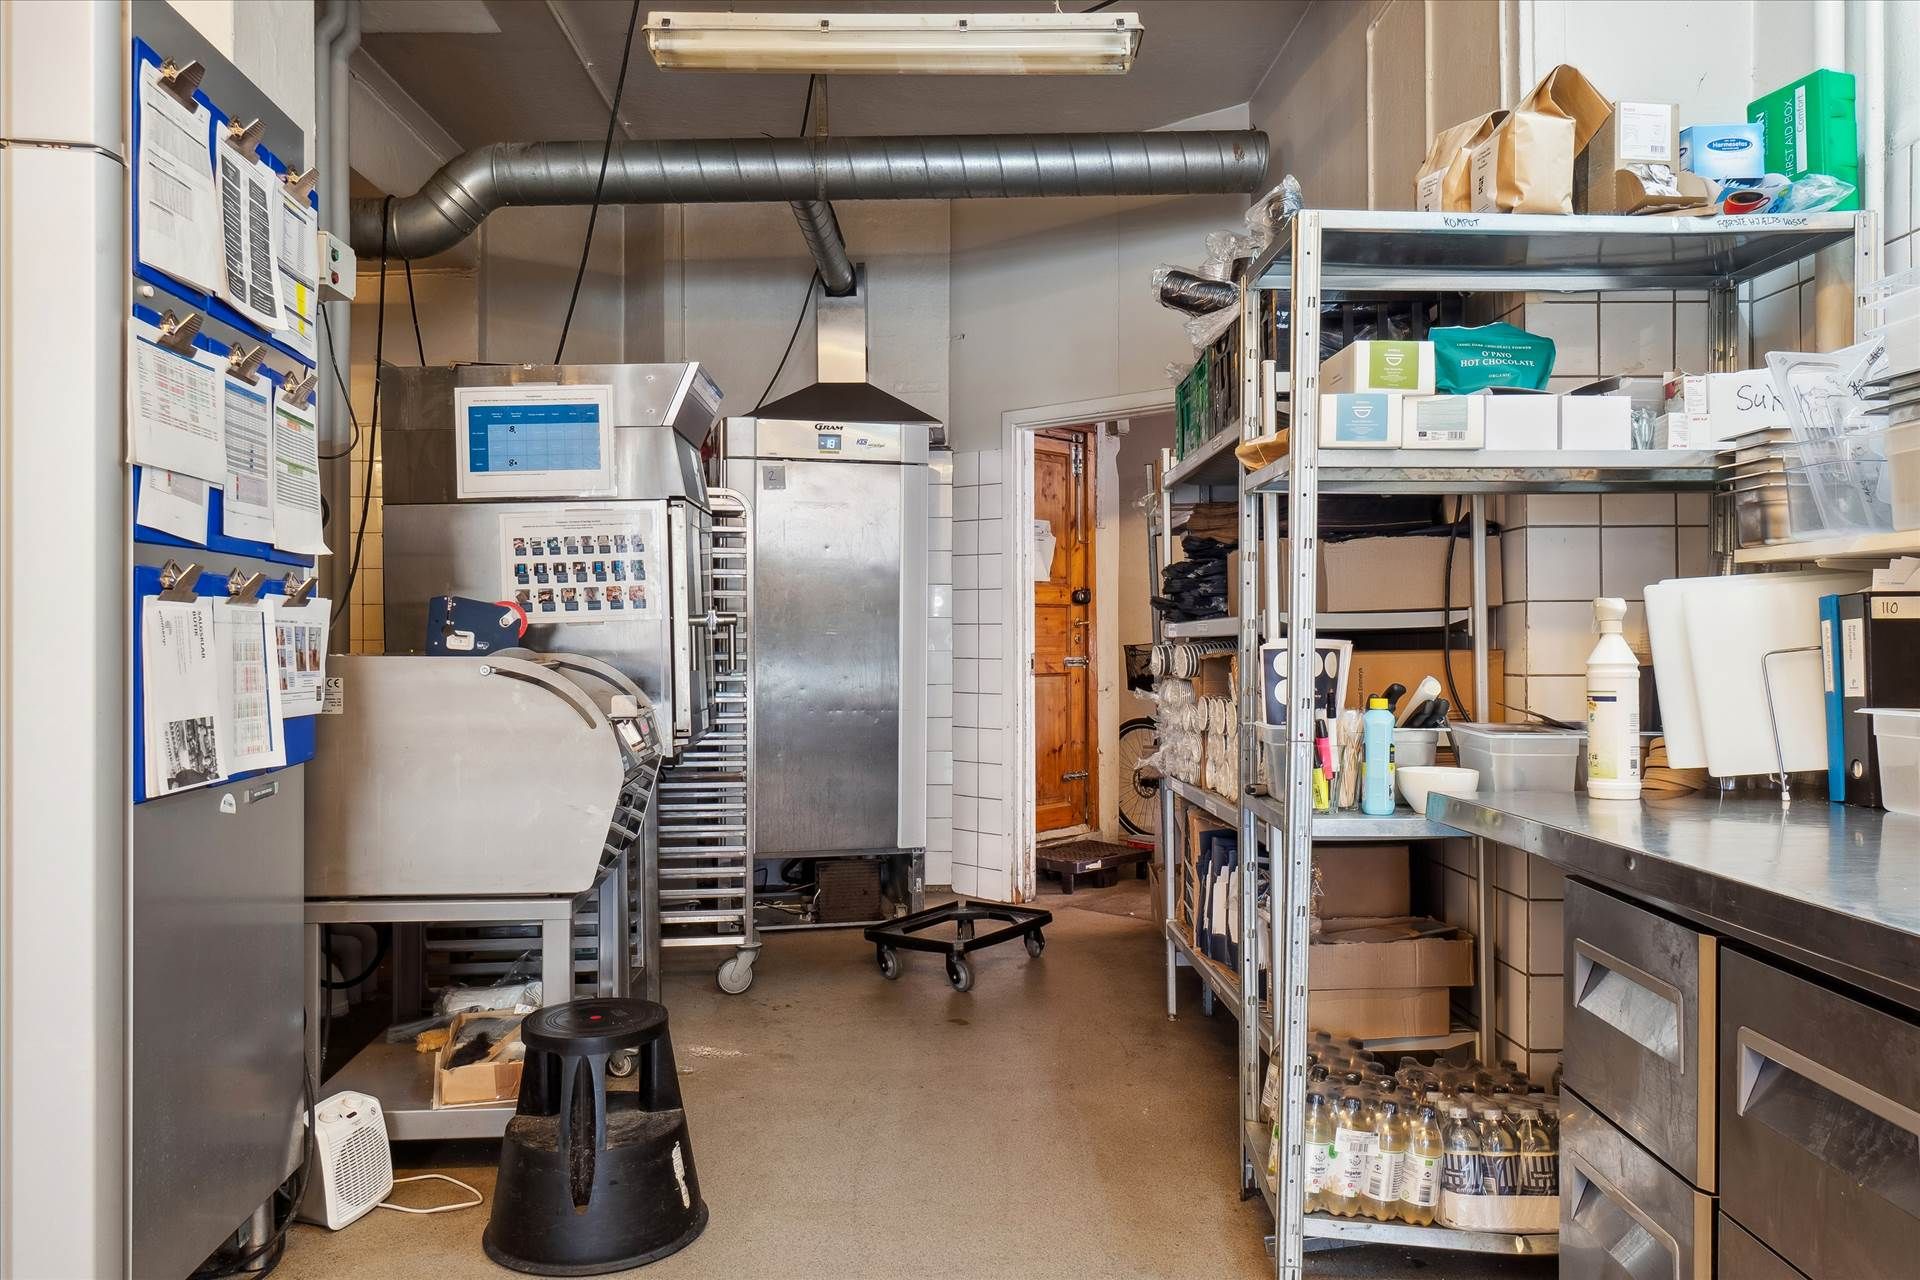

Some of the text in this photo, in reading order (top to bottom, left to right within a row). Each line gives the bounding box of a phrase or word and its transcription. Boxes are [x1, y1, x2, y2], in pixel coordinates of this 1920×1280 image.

[1796, 94, 1805, 134] Comfort
[1783, 97, 1794, 178] FIRST AID BOX
[1460, 358, 1536, 368] HOT CHOCOLATE
[1881, 601, 1899, 614] 110
